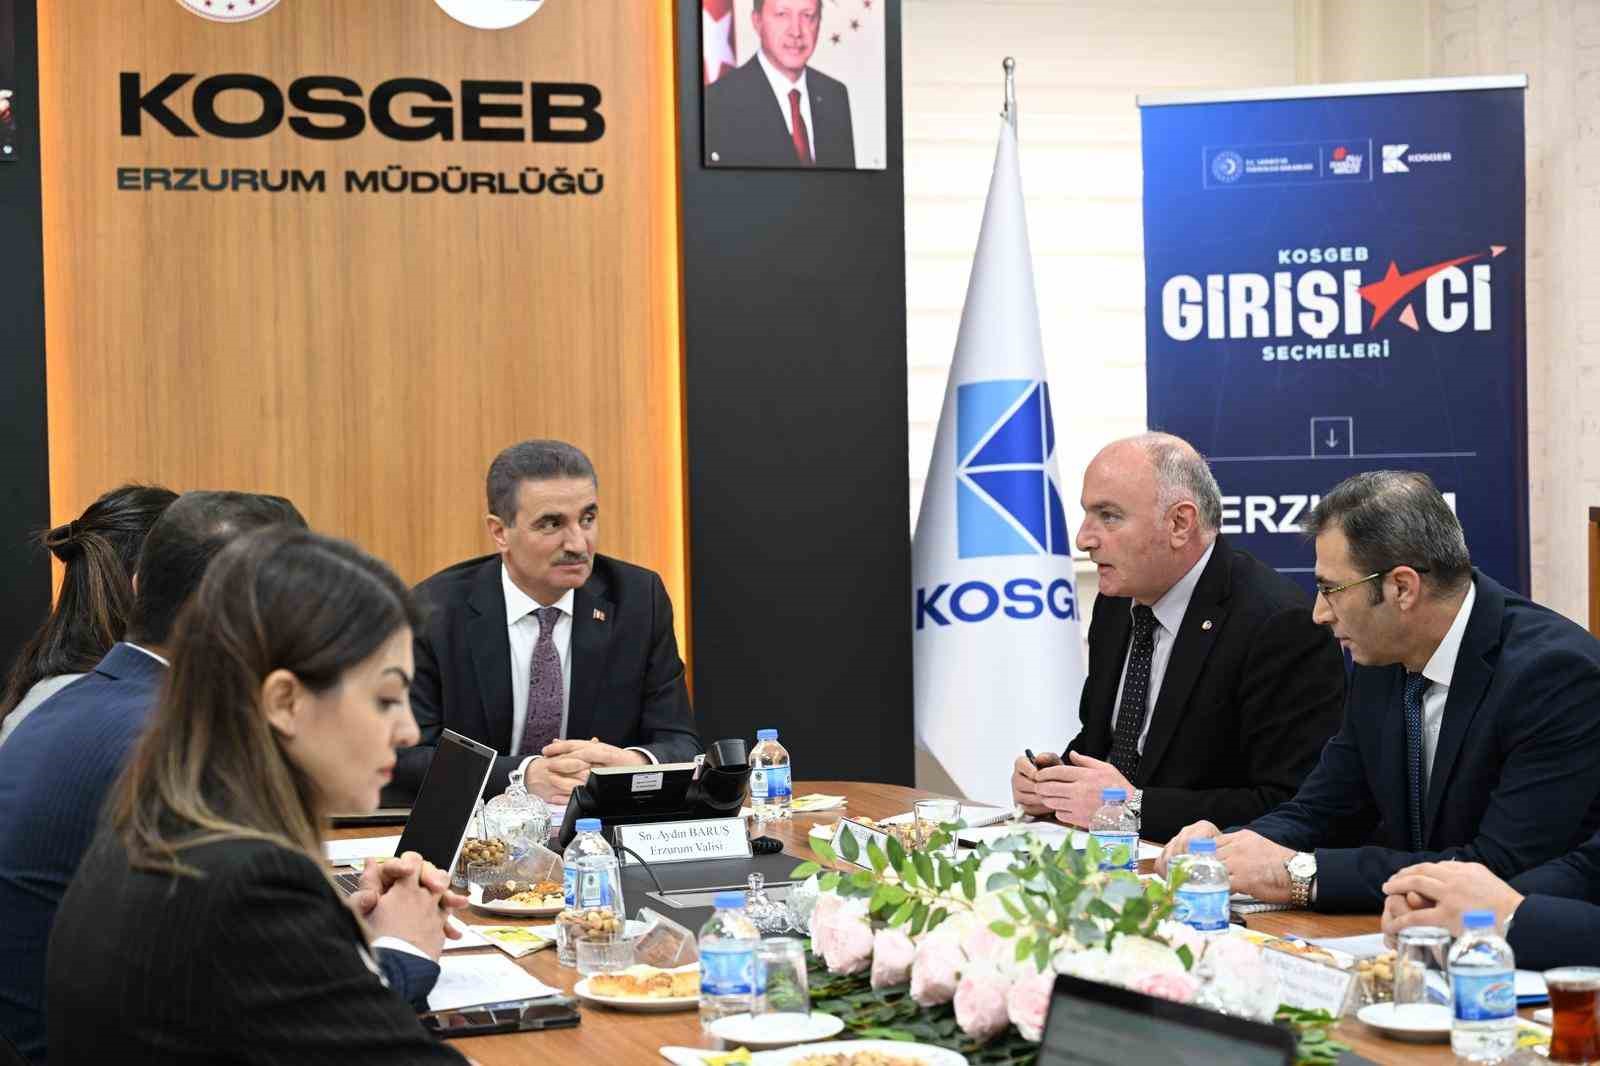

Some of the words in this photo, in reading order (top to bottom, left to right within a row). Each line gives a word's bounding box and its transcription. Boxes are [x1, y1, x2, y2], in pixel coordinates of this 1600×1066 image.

[120, 72, 606, 143] KOSGEB
[117, 168, 325, 192] ERZURUM
[345, 165, 604, 194] MÜDÜRLÜĞÜ
[1278, 246, 1369, 265] KOSGEB
[1262, 339, 1390, 362] SEÇMELERİ
[915, 577, 1079, 631] KOSG
[638, 831, 655, 842] Sn.
[650, 843, 693, 856] Erzurum
[695, 842, 723, 854] Valisi
